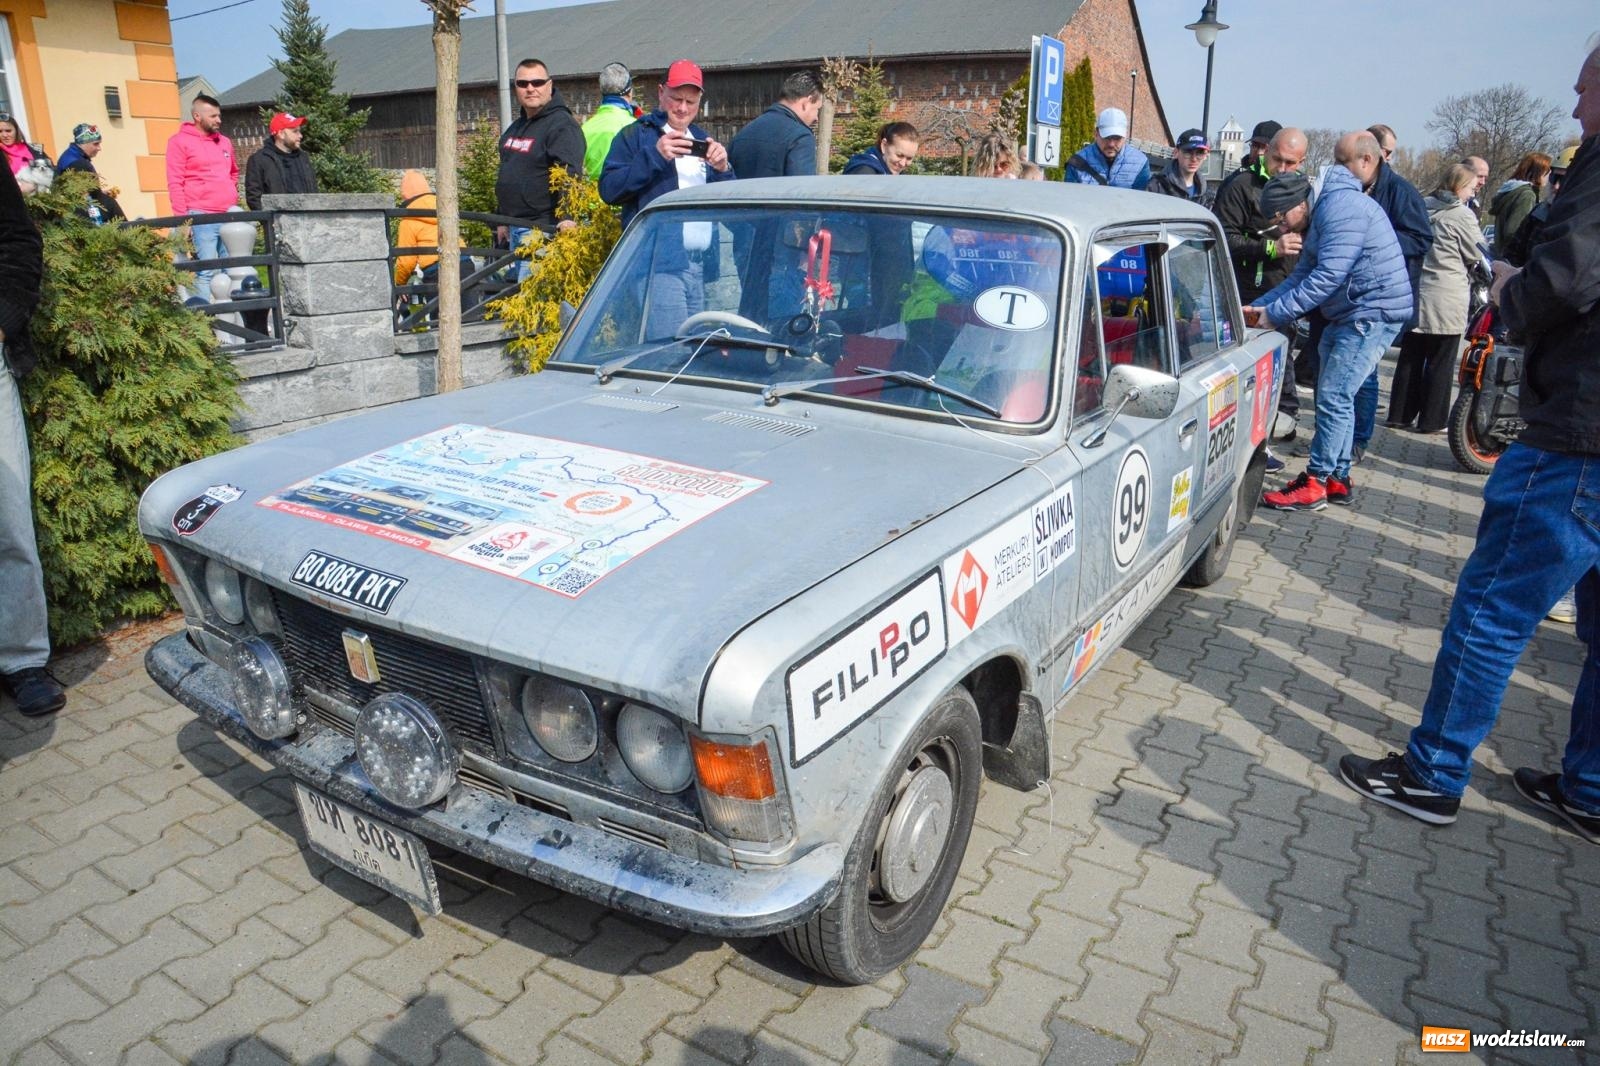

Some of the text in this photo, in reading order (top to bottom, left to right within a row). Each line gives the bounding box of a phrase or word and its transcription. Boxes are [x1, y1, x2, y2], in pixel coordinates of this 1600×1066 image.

[1045, 45, 1060, 98] P
[1000, 291, 1027, 326] T
[1208, 417, 1236, 467] 2026
[187, 503, 207, 520] 3
[1035, 492, 1074, 545] ŚLIWKA
[1119, 474, 1146, 545] 99
[994, 533, 1031, 570] MERKURY
[996, 552, 1032, 589] ATELIERS
[315, 561, 366, 597] 8081
[354, 572, 402, 609] PKT
[811, 610, 931, 721] FILIPPO
[353, 815, 416, 871] 8081
